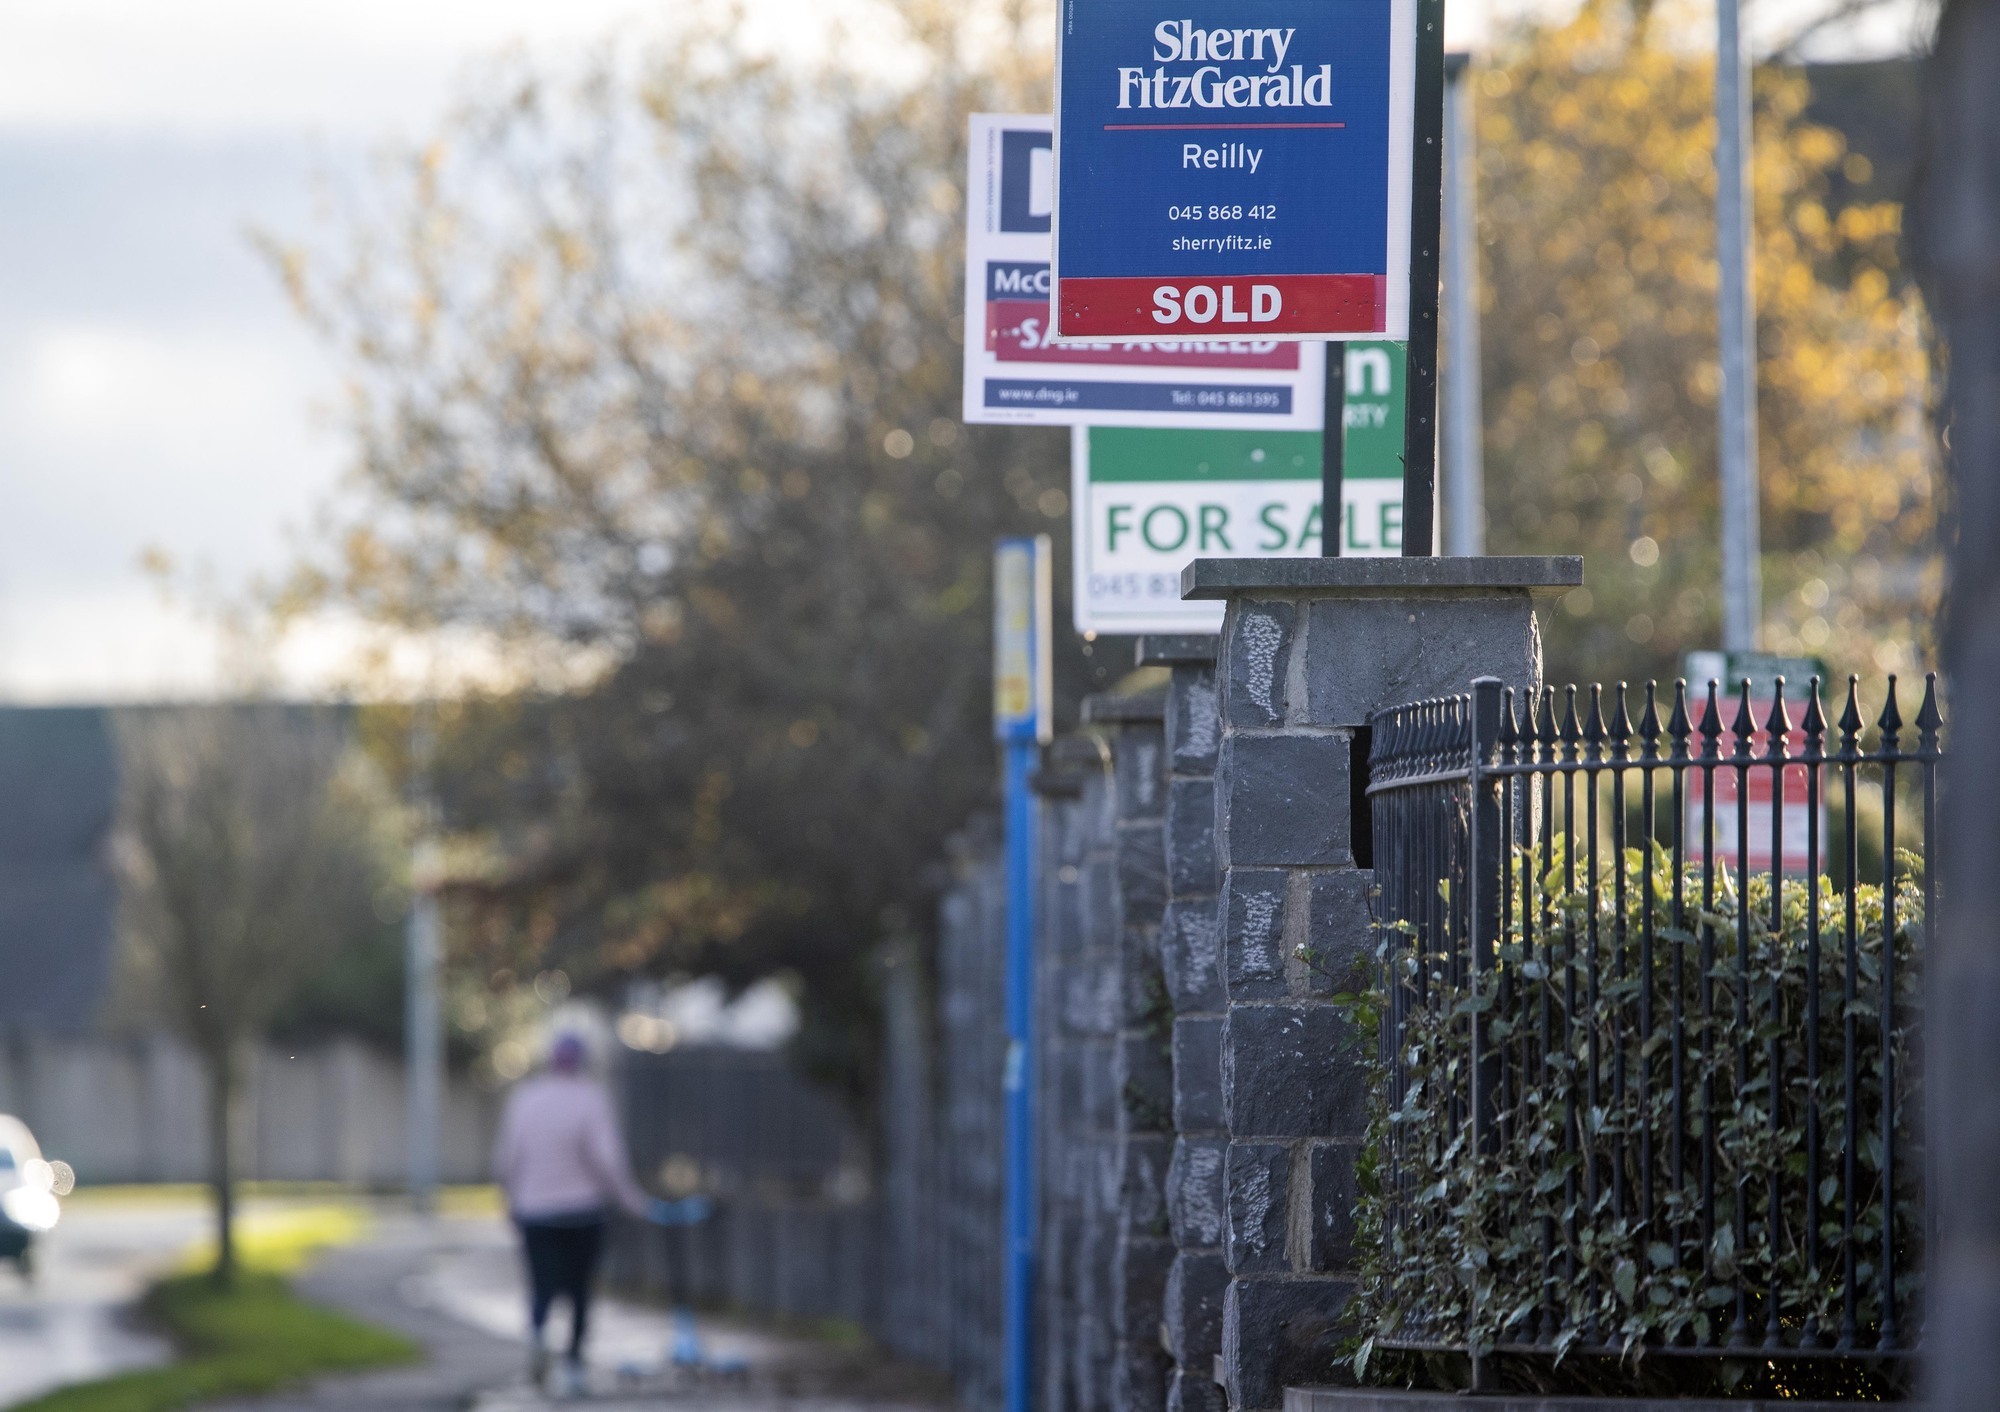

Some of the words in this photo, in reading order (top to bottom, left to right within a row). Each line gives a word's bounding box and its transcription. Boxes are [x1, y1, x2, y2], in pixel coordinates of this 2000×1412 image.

[1153, 19, 1295, 73] Sherry
[1116, 64, 1332, 109] FitzGerald
[1182, 142, 1263, 174] Reilly
[1168, 205, 1203, 220] 045
[1208, 205, 1243, 220] 868
[1247, 204, 1277, 219] 412
[1172, 235, 1272, 253] sherryfitz.ie
[1151, 284, 1282, 324] SOLD
[999, 387, 1079, 405] www.dng.ie
[1107, 503, 1233, 552] FOR
[1259, 503, 1403, 550] SALE
